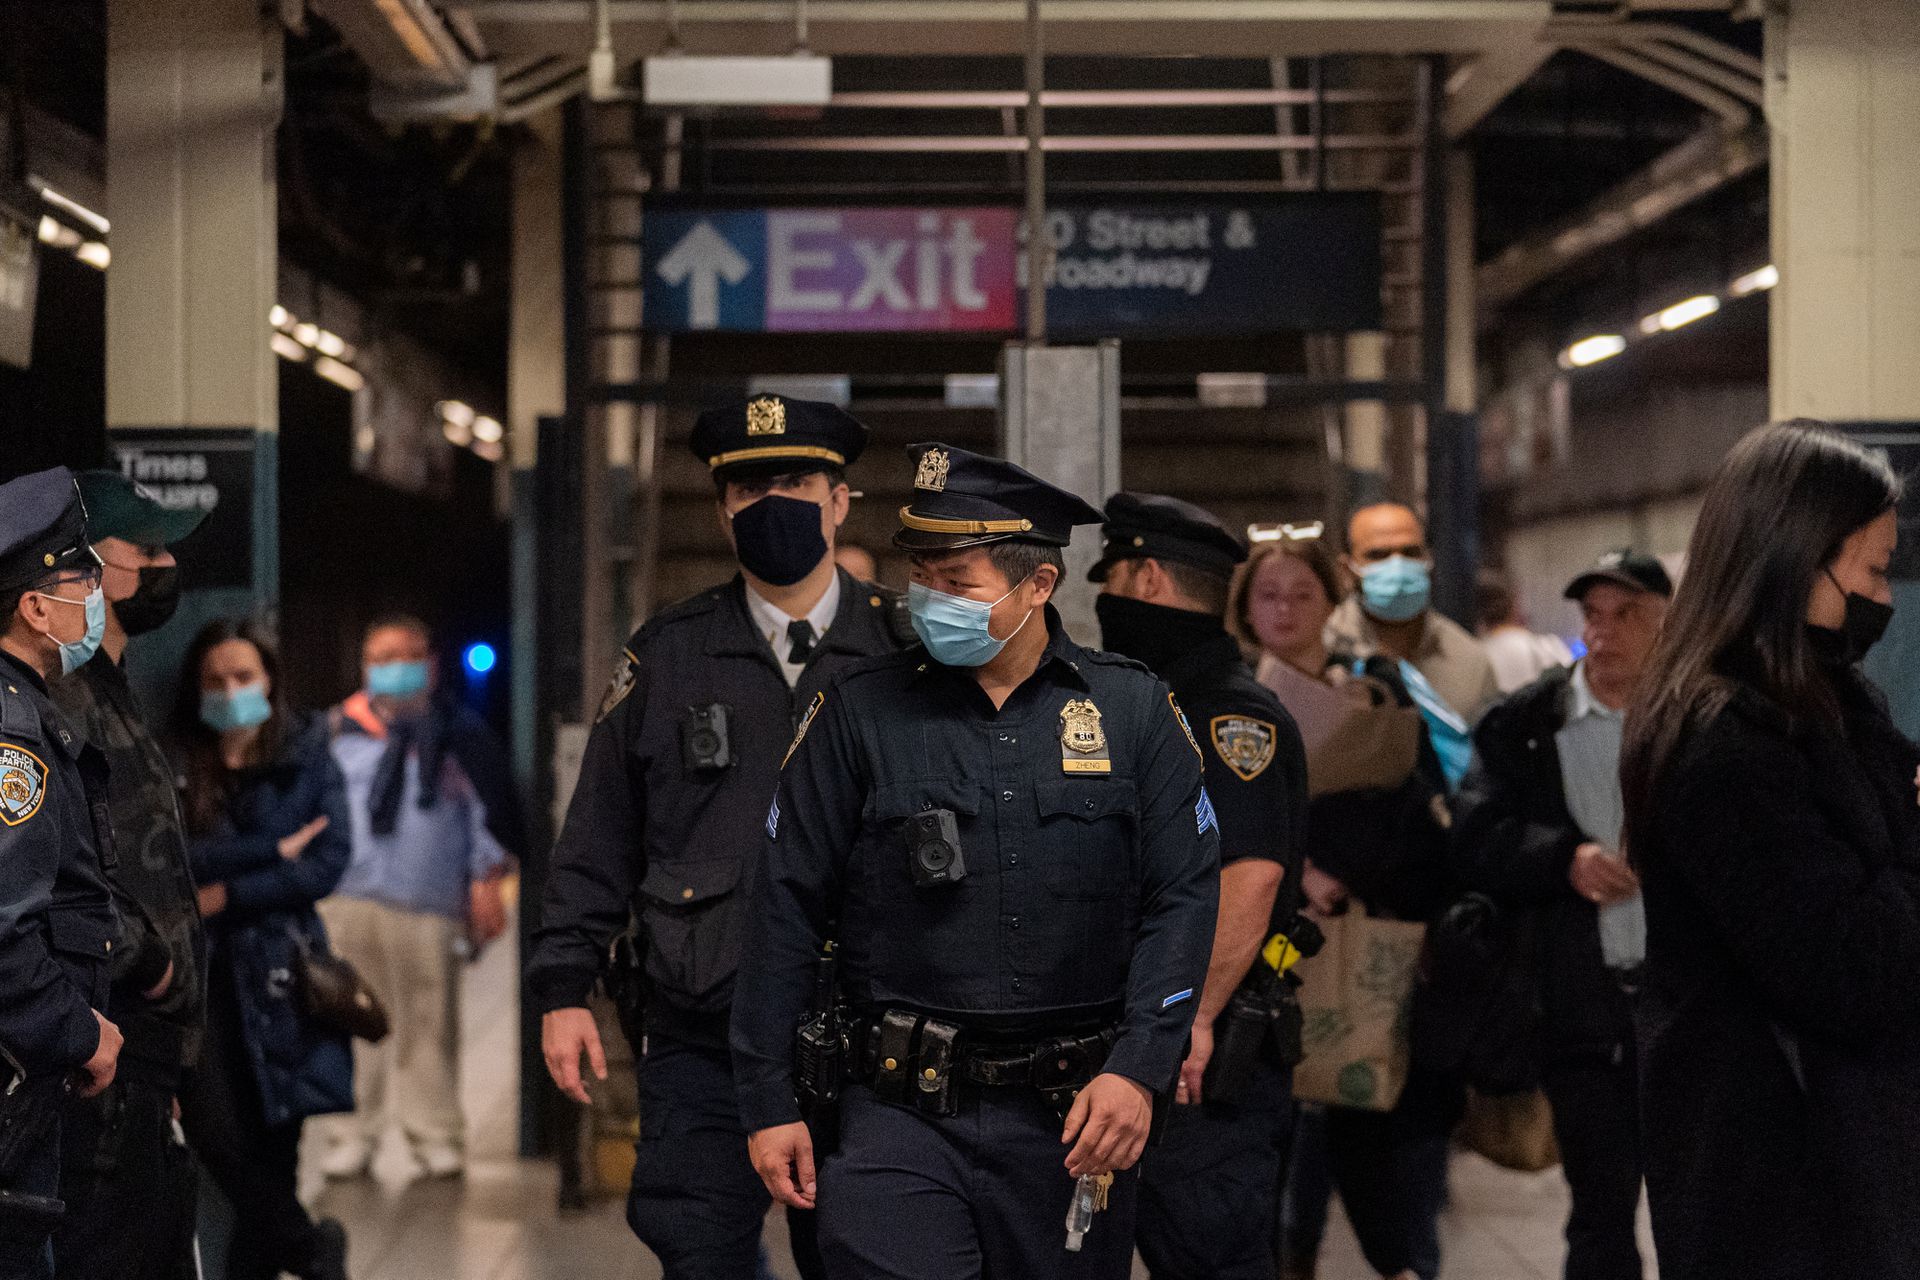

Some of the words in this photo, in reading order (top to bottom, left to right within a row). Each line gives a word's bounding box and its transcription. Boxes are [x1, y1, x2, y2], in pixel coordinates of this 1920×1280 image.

[1088, 210, 1211, 249] Street
[1224, 209, 1256, 249] &
[767, 210, 987, 311] Exit
[116, 448, 208, 481] Times
[4, 749, 34, 767] POLICE
[1075, 762, 1101, 770] ZHENG
[17, 804, 33, 818] NEW
